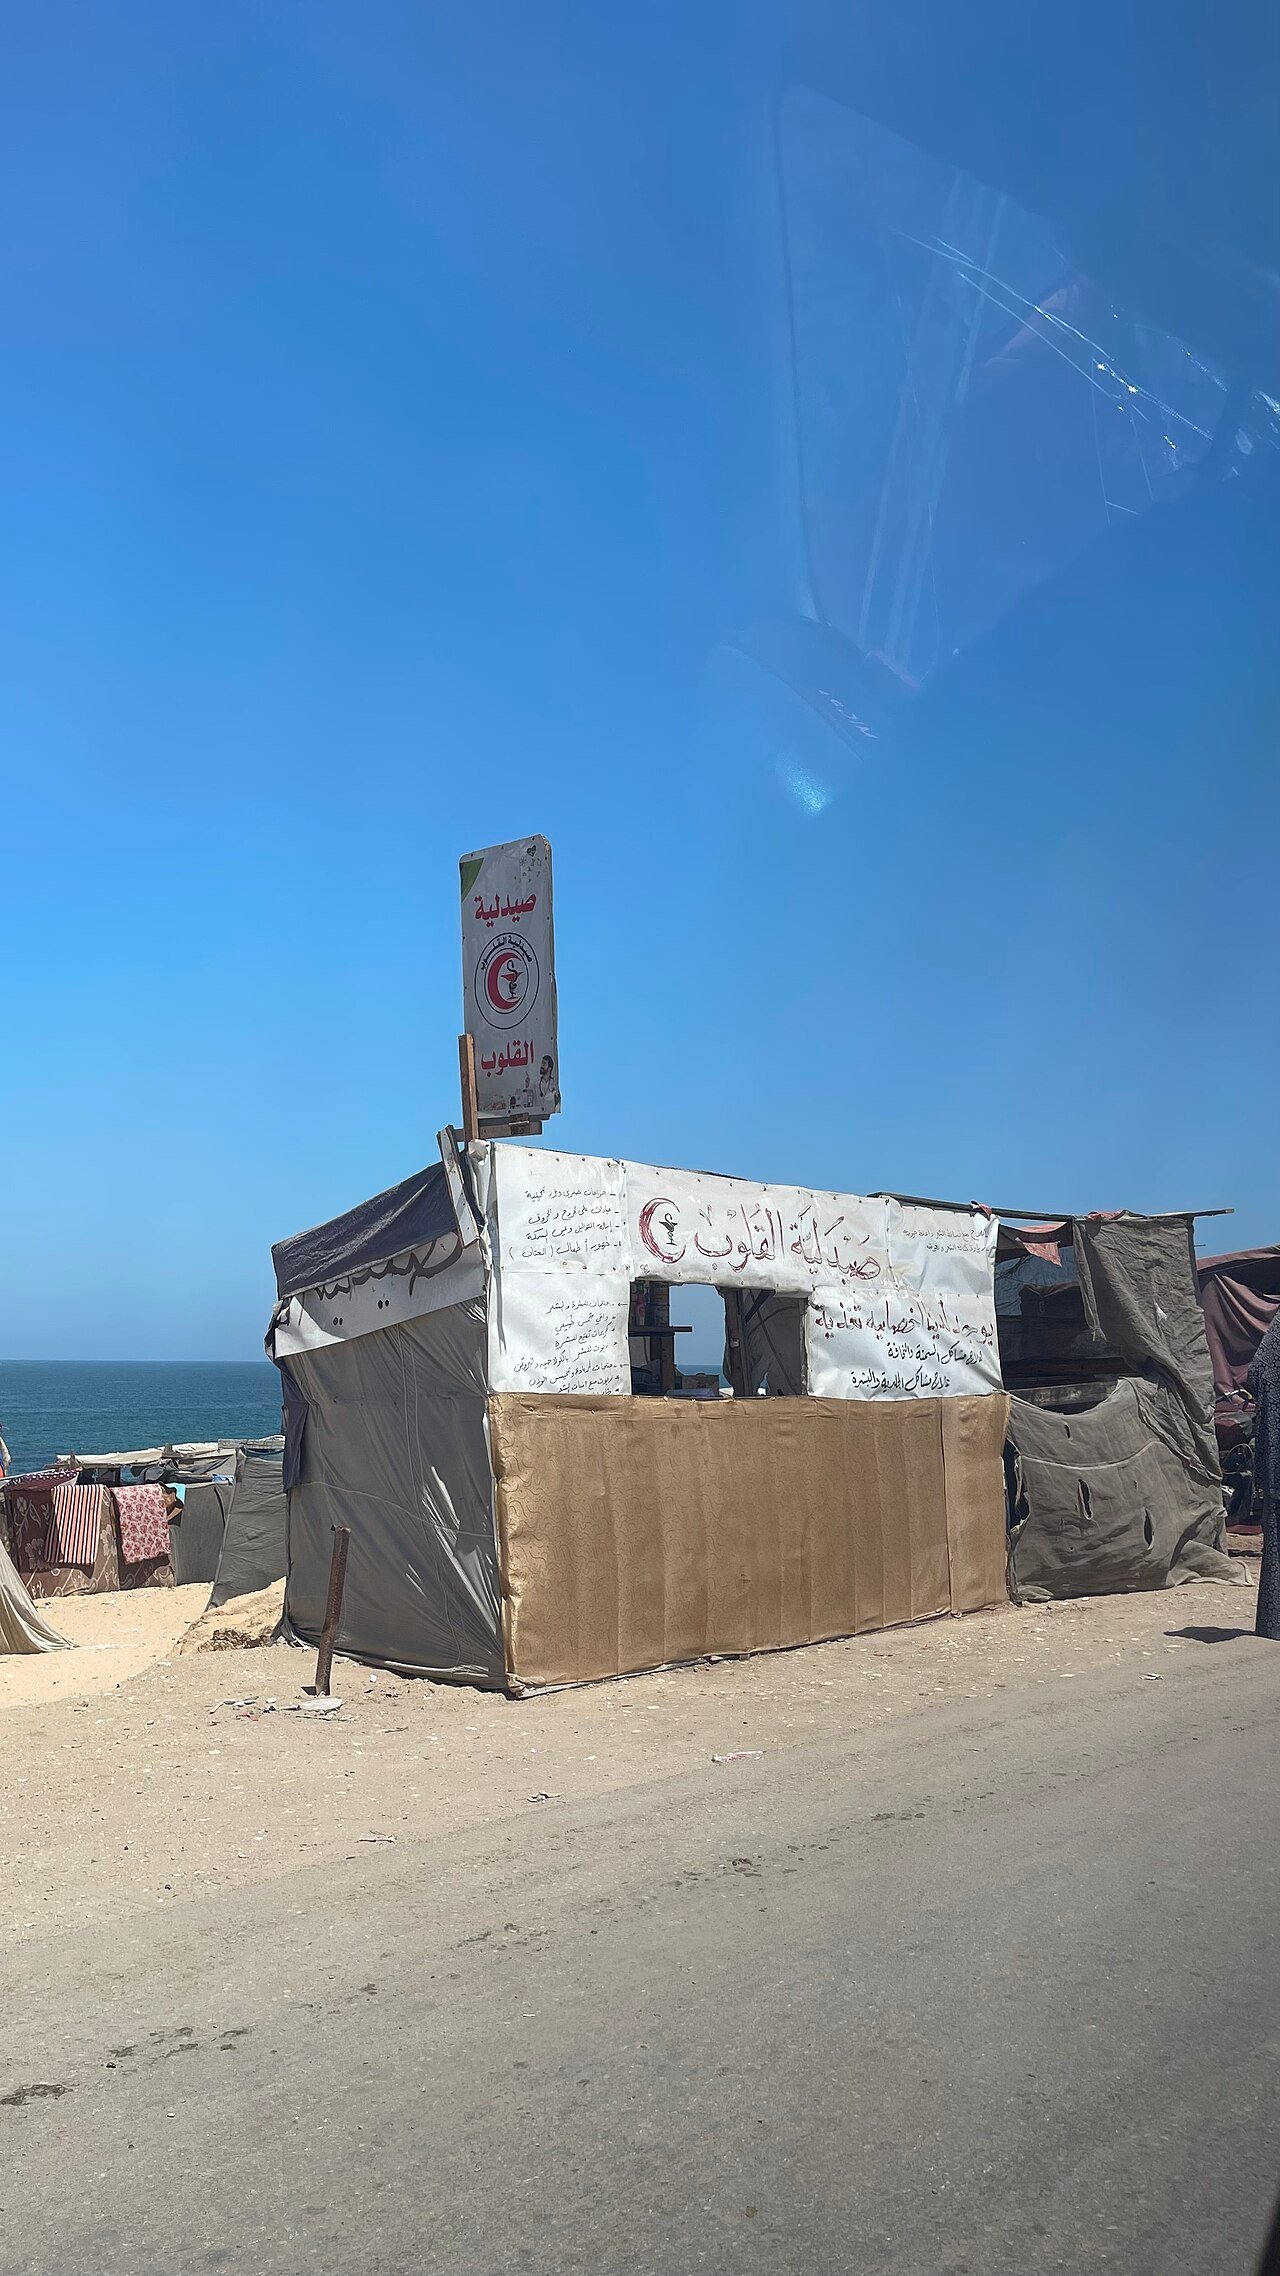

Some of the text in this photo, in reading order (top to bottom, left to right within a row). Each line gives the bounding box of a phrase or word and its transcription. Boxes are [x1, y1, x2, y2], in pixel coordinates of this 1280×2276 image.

[474, 893, 537, 928] صيدلية
[481, 1039, 534, 1078] القلوب
[693, 1203, 881, 1285] صيدلية القلوب
